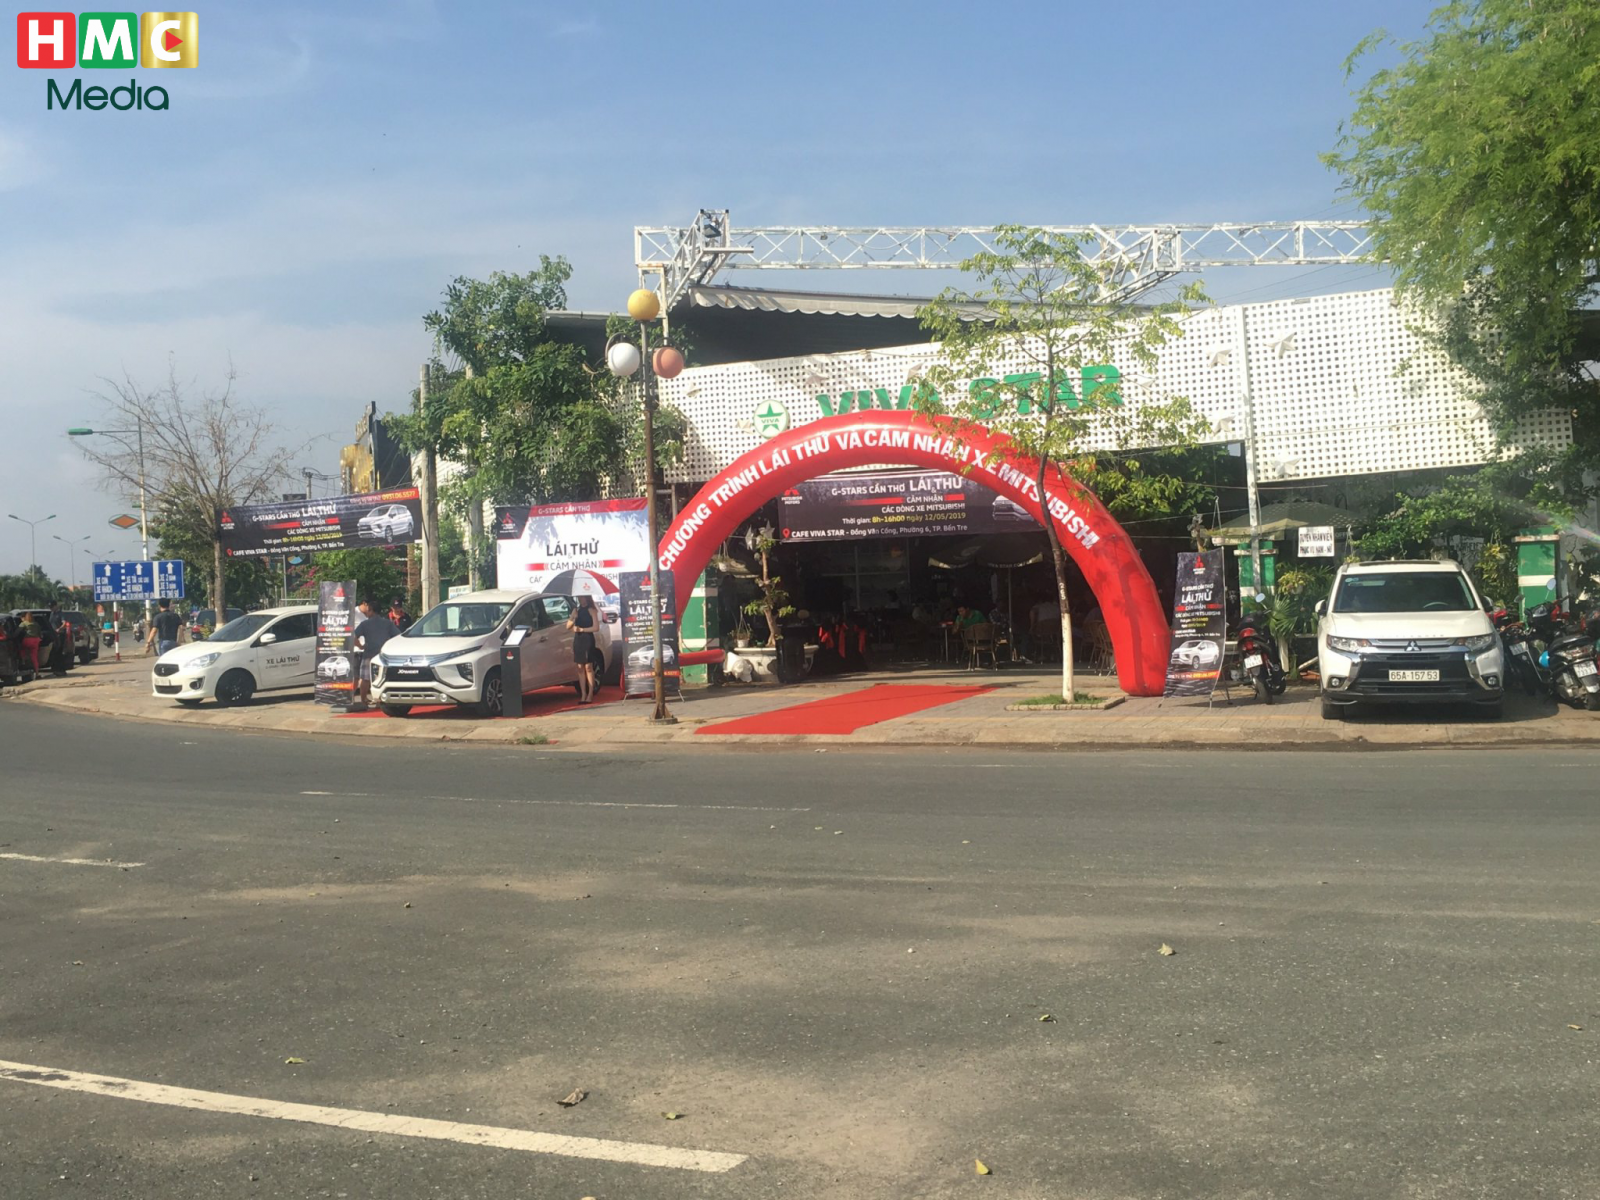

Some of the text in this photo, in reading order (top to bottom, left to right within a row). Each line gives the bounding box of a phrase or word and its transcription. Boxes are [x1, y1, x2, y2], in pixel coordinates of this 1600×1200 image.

[832, 486, 868, 496] G-STARS
[909, 476, 931, 492] LÁI
[302, 504, 316, 517] LÁI
[658, 503, 712, 571] CHƯƠNG
[708, 465, 760, 507] TRÌNH
[760, 447, 791, 475] LÁI
[916, 504, 925, 512] XE
[926, 503, 966, 511] MITSUBISHI
[872, 515, 905, 524] 8h-16h00
[924, 512, 966, 521] 12/05/2019
[827, 529, 845, 537] STAR
[546, 541, 567, 556] LÁI
[570, 538, 599, 555] THỬ
[1182, 589, 1212, 603] LÁI THỬ
[630, 604, 645, 615] LÁI
